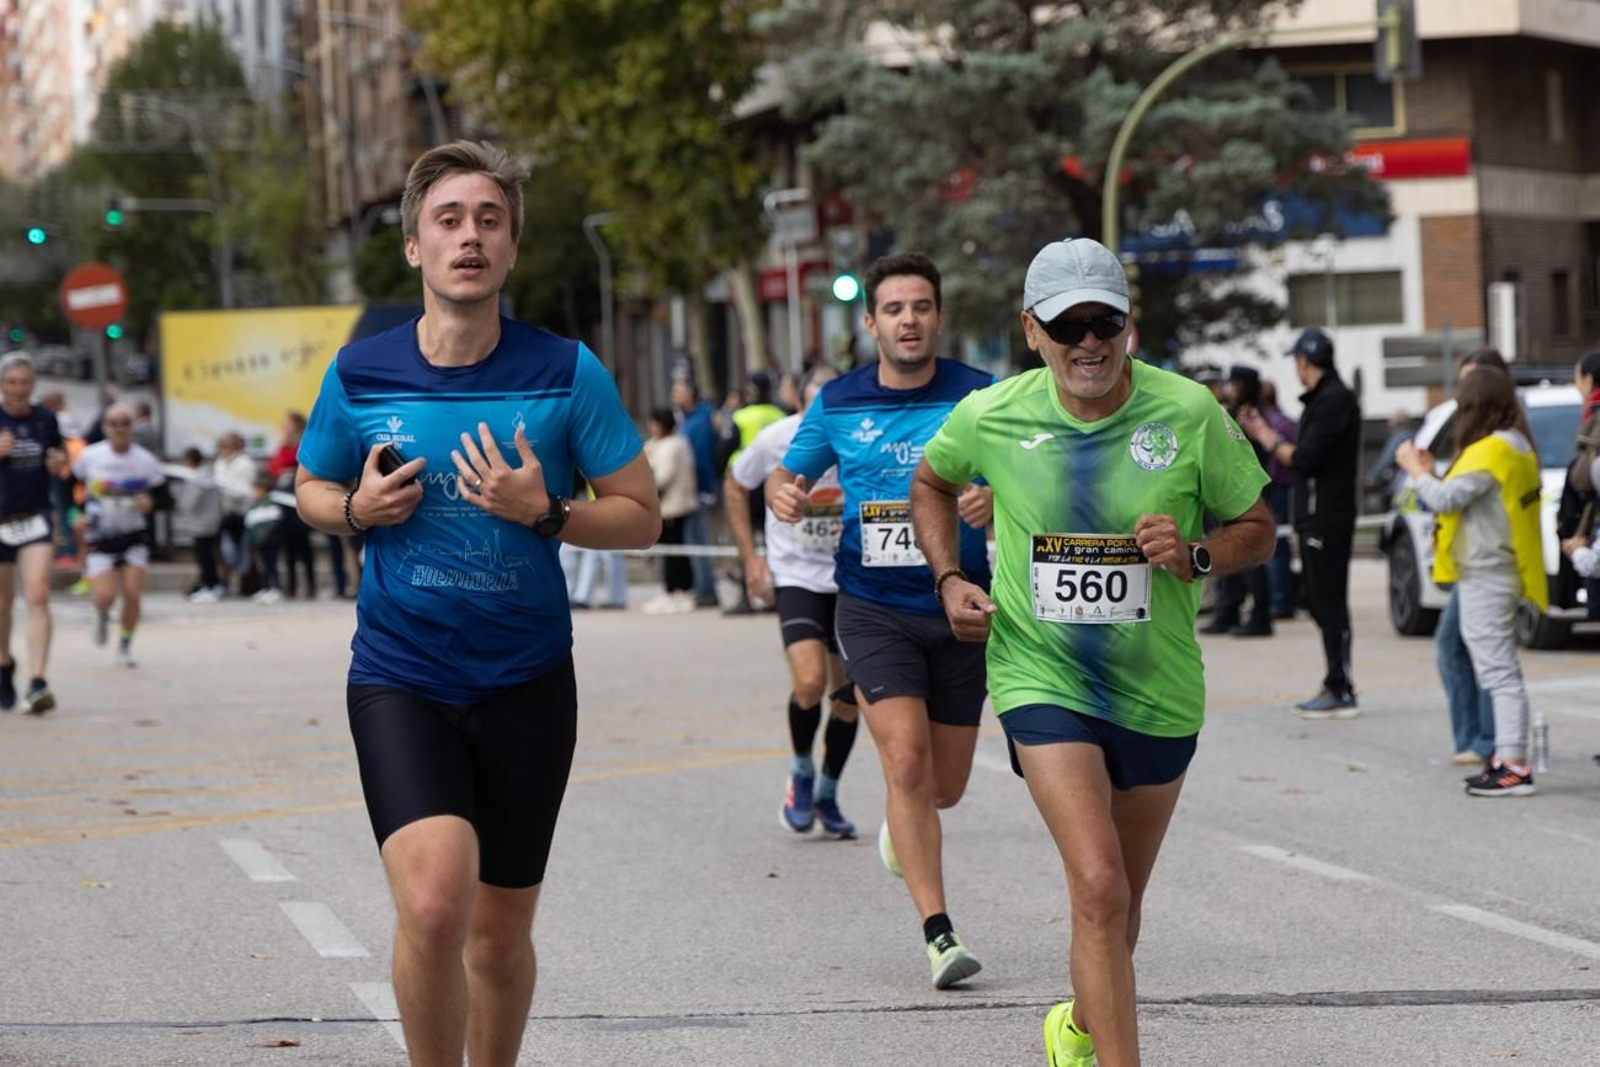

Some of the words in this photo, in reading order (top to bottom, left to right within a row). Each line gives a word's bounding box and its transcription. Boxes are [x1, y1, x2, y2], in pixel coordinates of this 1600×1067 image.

[877, 526, 921, 551] 74
[1063, 538, 1105, 547] CARRERA
[1107, 539, 1137, 548] POPUL
[1055, 569, 1128, 604] 560
